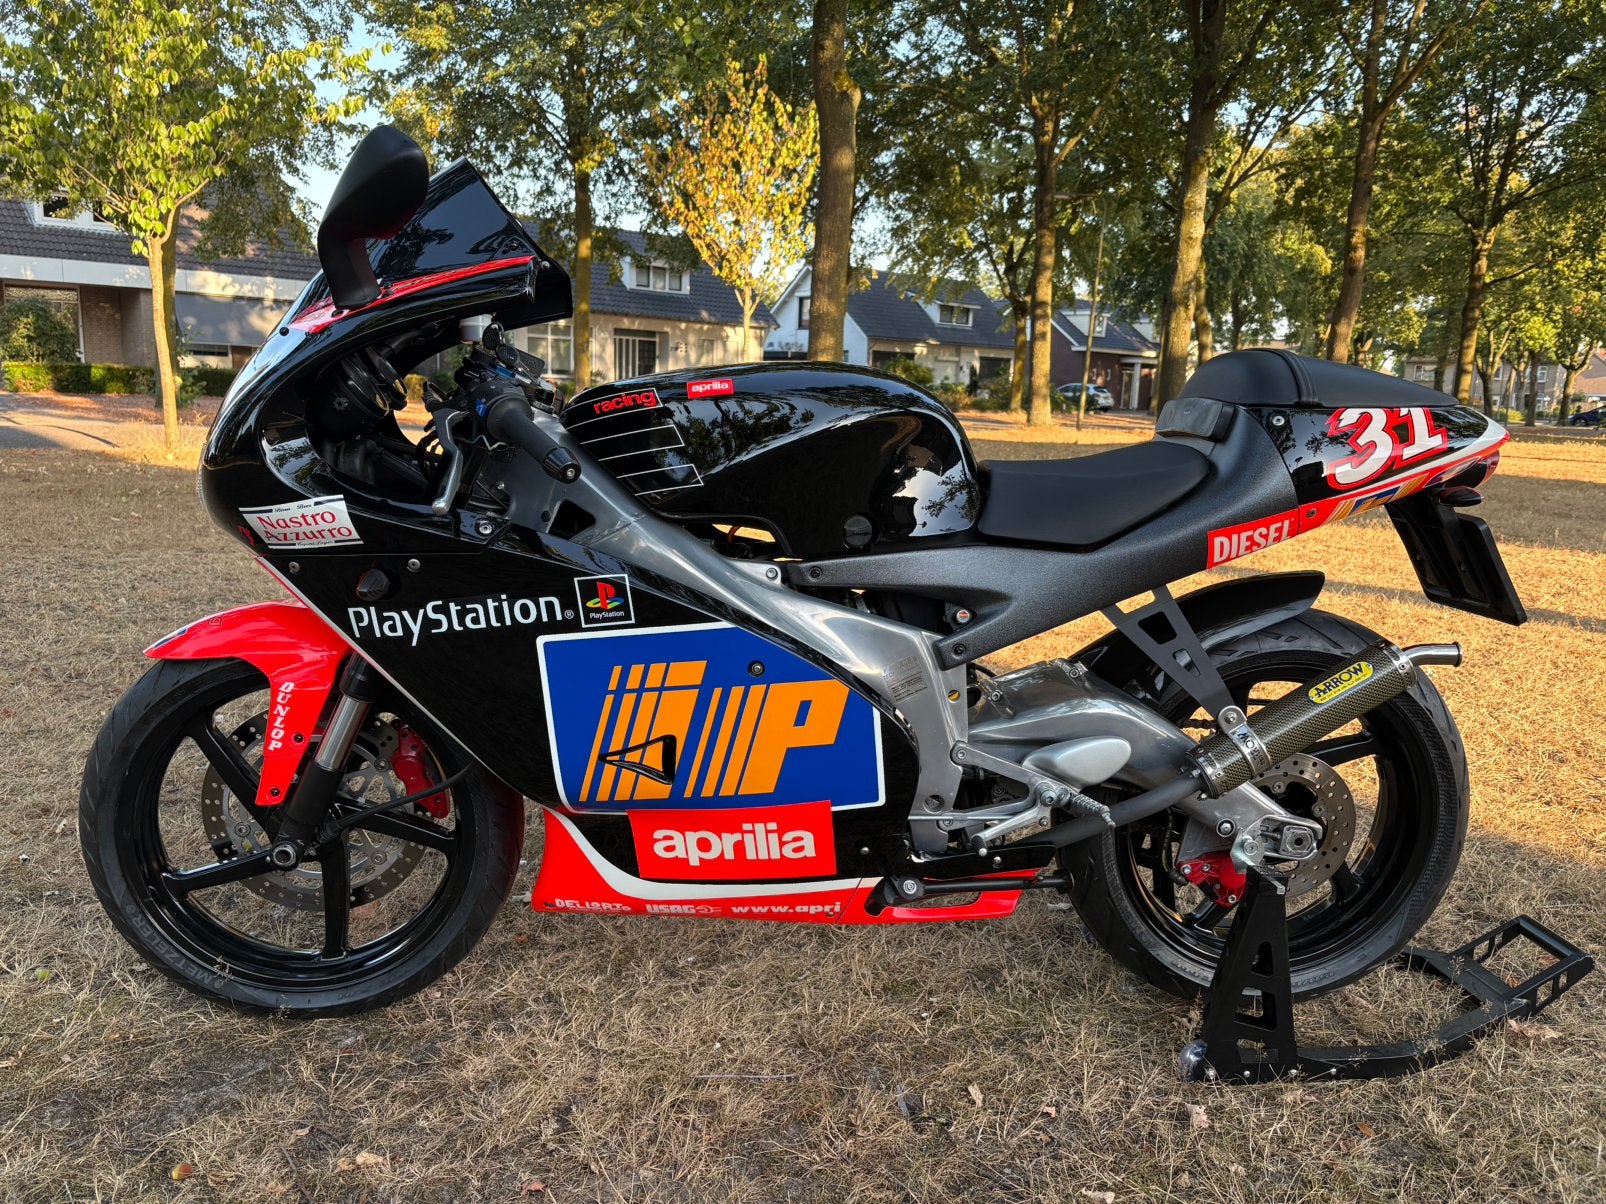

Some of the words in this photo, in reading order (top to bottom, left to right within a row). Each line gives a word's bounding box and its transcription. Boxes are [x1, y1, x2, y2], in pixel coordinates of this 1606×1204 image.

[691, 381, 729, 393] aprilia
[593, 391, 657, 415] racing
[1327, 407, 1447, 489] 31
[257, 511, 337, 531] Nastro
[265, 526, 353, 542] Azzurro
[1213, 519, 1291, 564] DIESEL
[348, 594, 562, 647] PlayStation
[589, 610, 625, 620] PlayStation
[1314, 662, 1364, 698] ARROW
[268, 682, 295, 751] DUNLOP
[653, 822, 816, 866] aprilia
[646, 903, 696, 915] USAG
[731, 902, 841, 915] www.apri
[132, 914, 214, 985] METZELER
